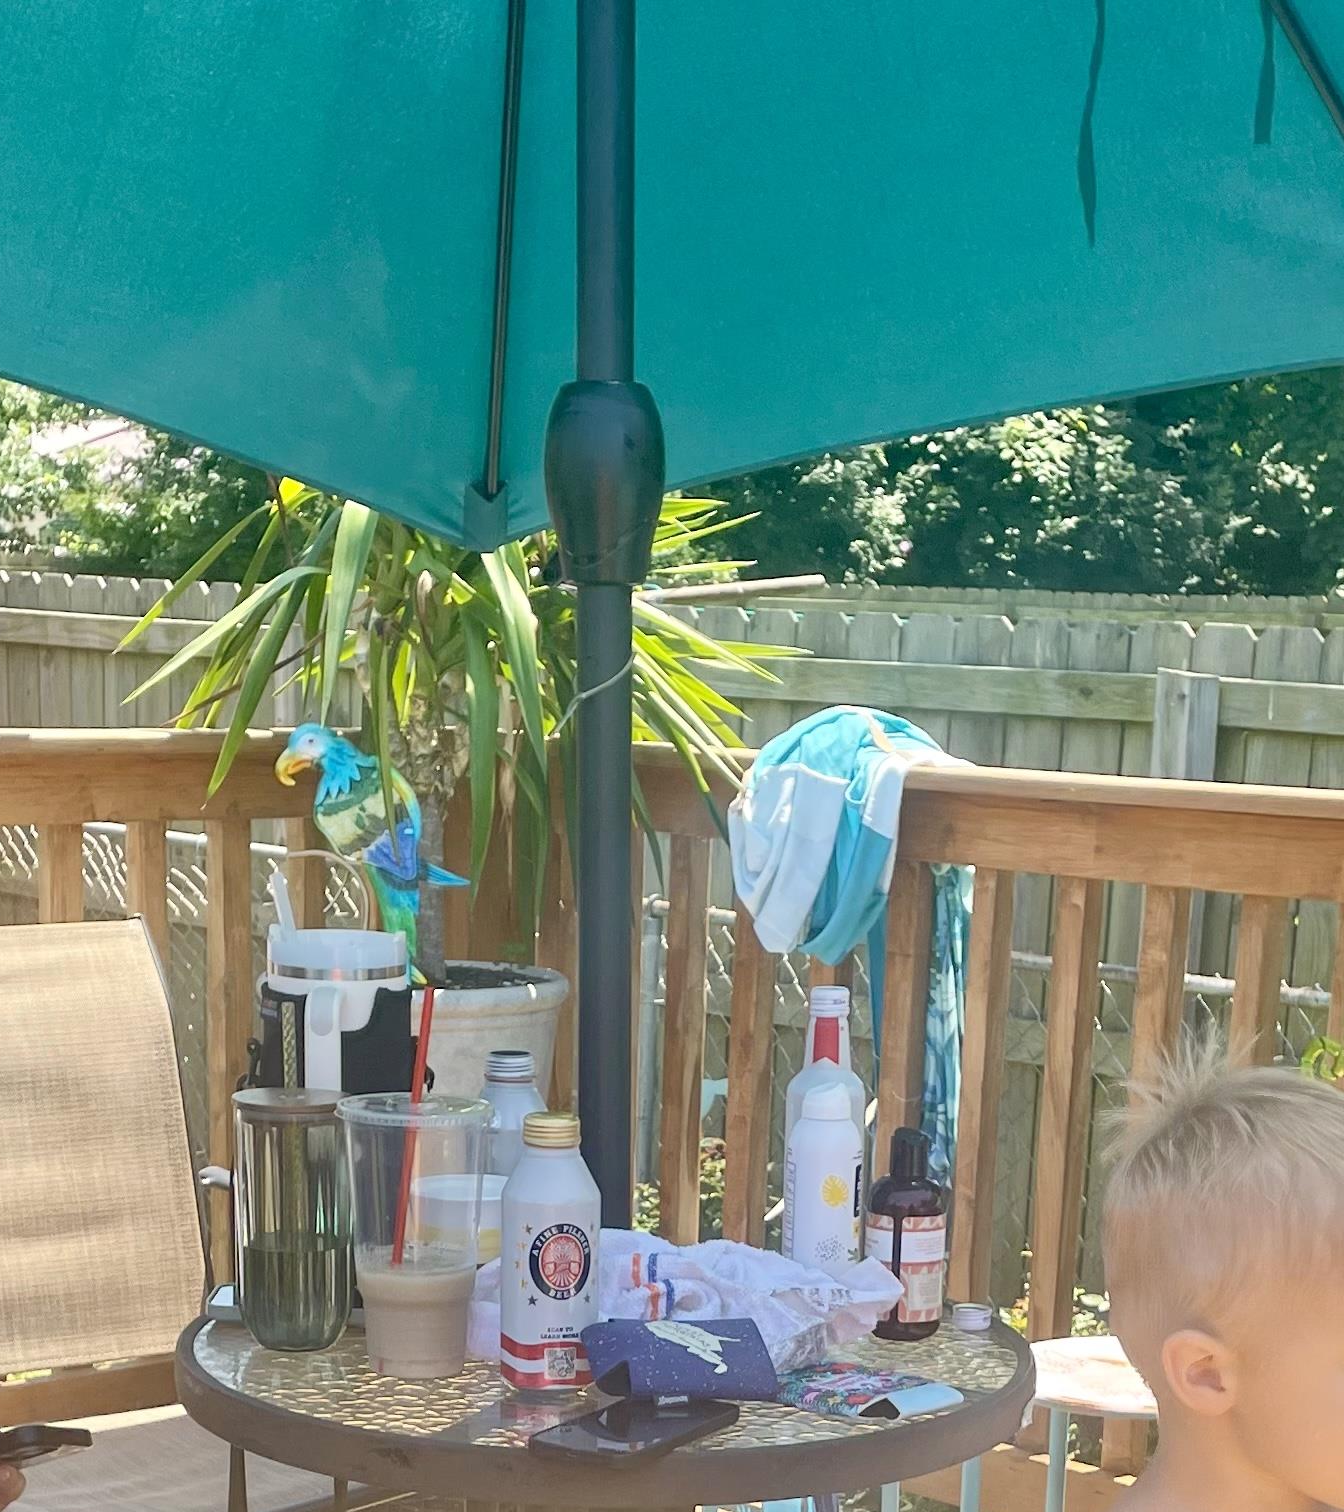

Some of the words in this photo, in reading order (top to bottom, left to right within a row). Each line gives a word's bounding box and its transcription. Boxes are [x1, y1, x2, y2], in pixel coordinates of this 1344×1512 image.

[535, 1227, 559, 1247] FINE
[563, 1225, 590, 1255] PILSNER
[532, 1249, 539, 1257] A
[548, 1287, 577, 1298] BEER
